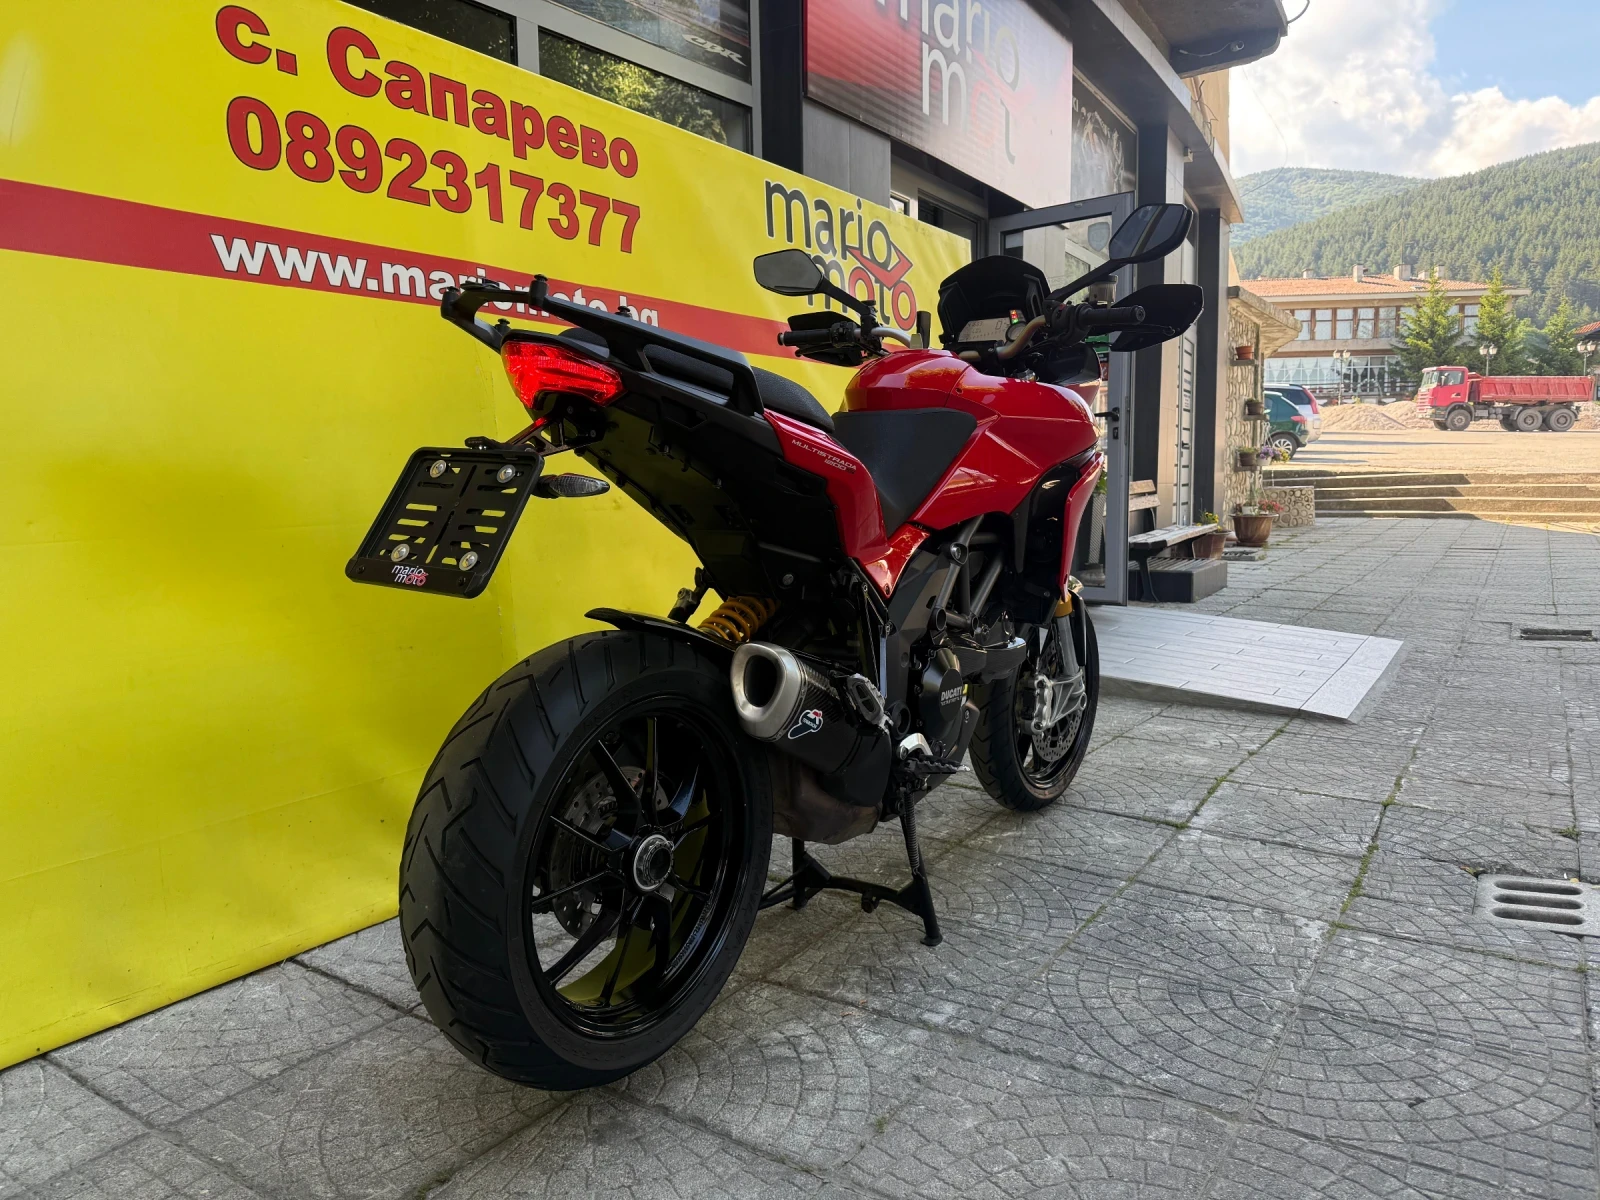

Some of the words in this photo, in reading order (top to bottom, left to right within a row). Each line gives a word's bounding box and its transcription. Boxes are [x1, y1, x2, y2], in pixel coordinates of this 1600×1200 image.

[682, 34, 747, 67] CBR
[215, 5, 298, 76] с.
[326, 26, 639, 178] Сапарево
[226, 95, 641, 254] 0892317377
[764, 180, 892, 272] mario
[791, 439, 857, 470] MULTISTRADA
[391, 565, 424, 575] mario
[394, 573, 427, 586] moto
[940, 686, 963, 702] DUCATI
